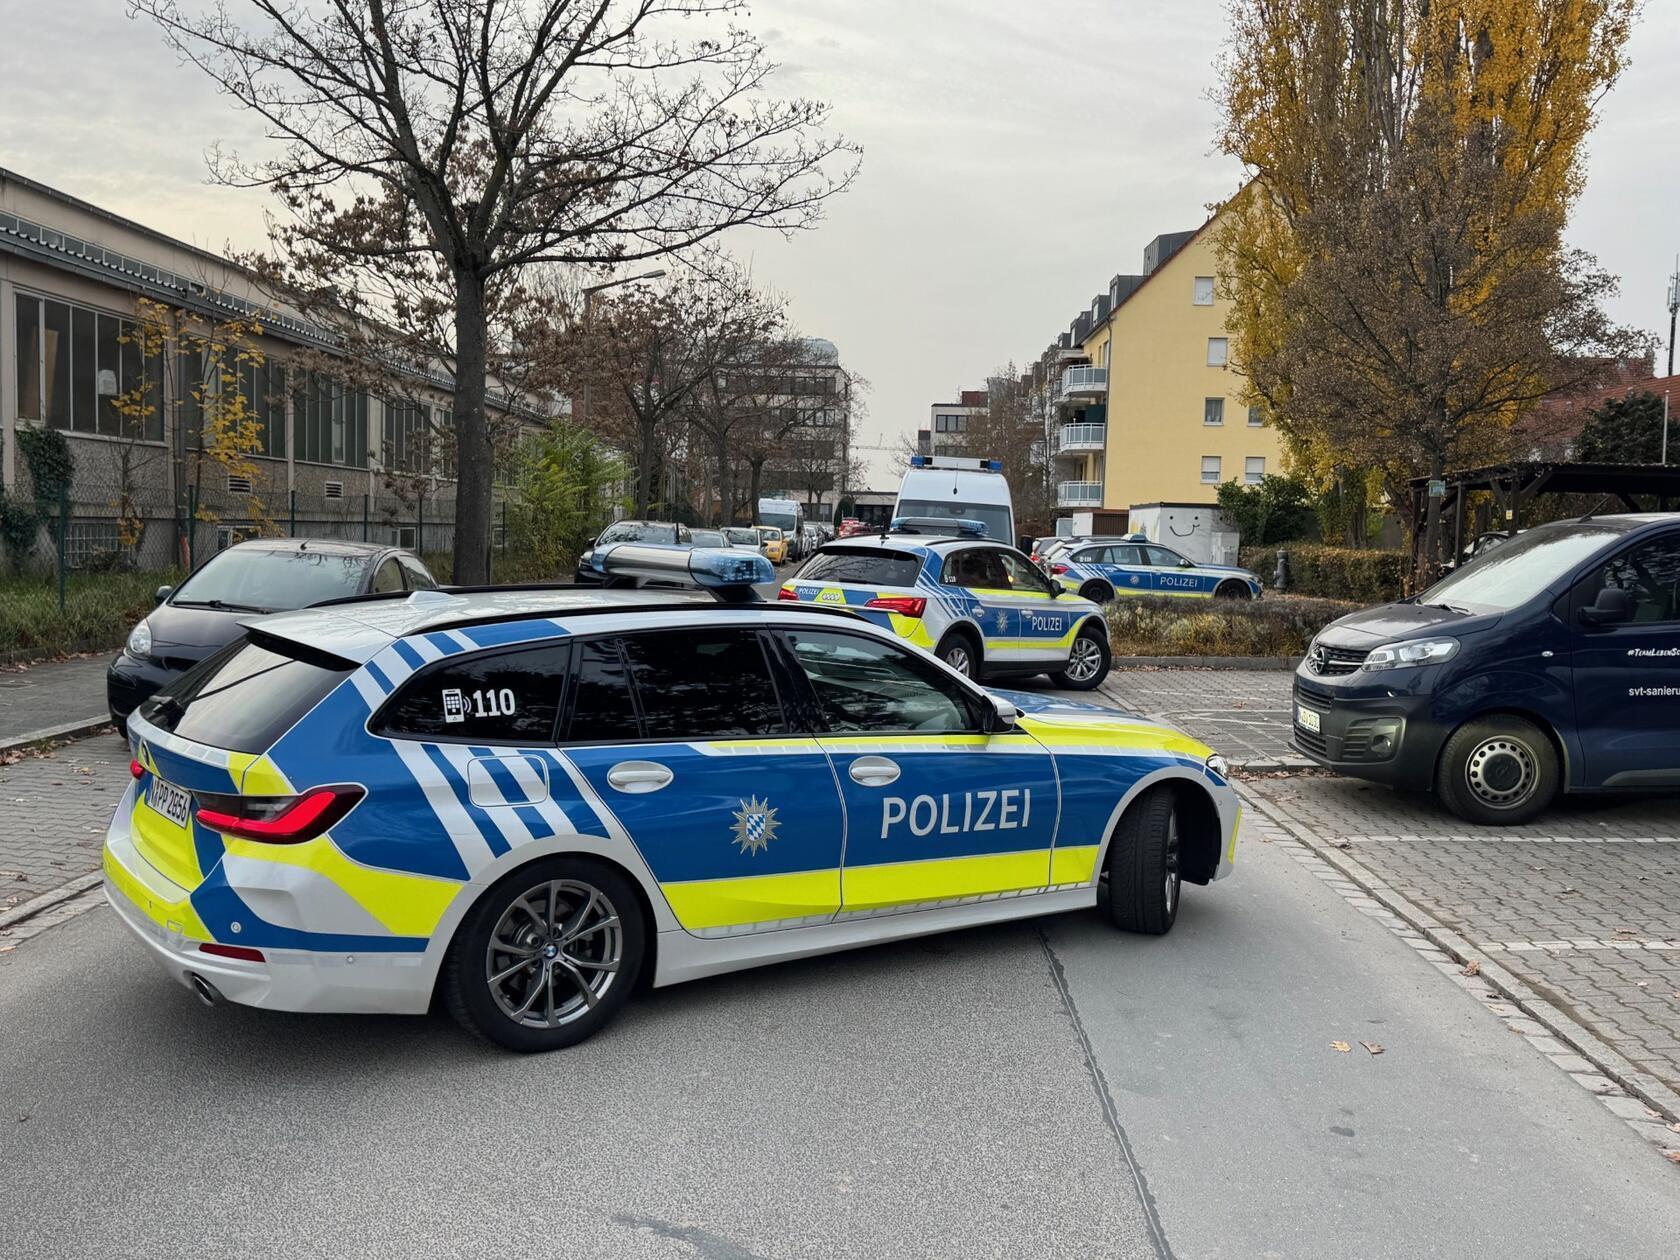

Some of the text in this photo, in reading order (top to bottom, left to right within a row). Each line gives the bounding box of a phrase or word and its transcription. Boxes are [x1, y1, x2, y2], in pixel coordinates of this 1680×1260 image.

[1159, 576, 1198, 588] POLIZEI
[799, 587, 819, 595] POLIZEI
[1031, 616, 1063, 631] POLIZEI
[1628, 685, 1680, 696] svt-sanieru
[472, 688, 516, 718] 110
[880, 788, 1031, 839] POLIZEI
